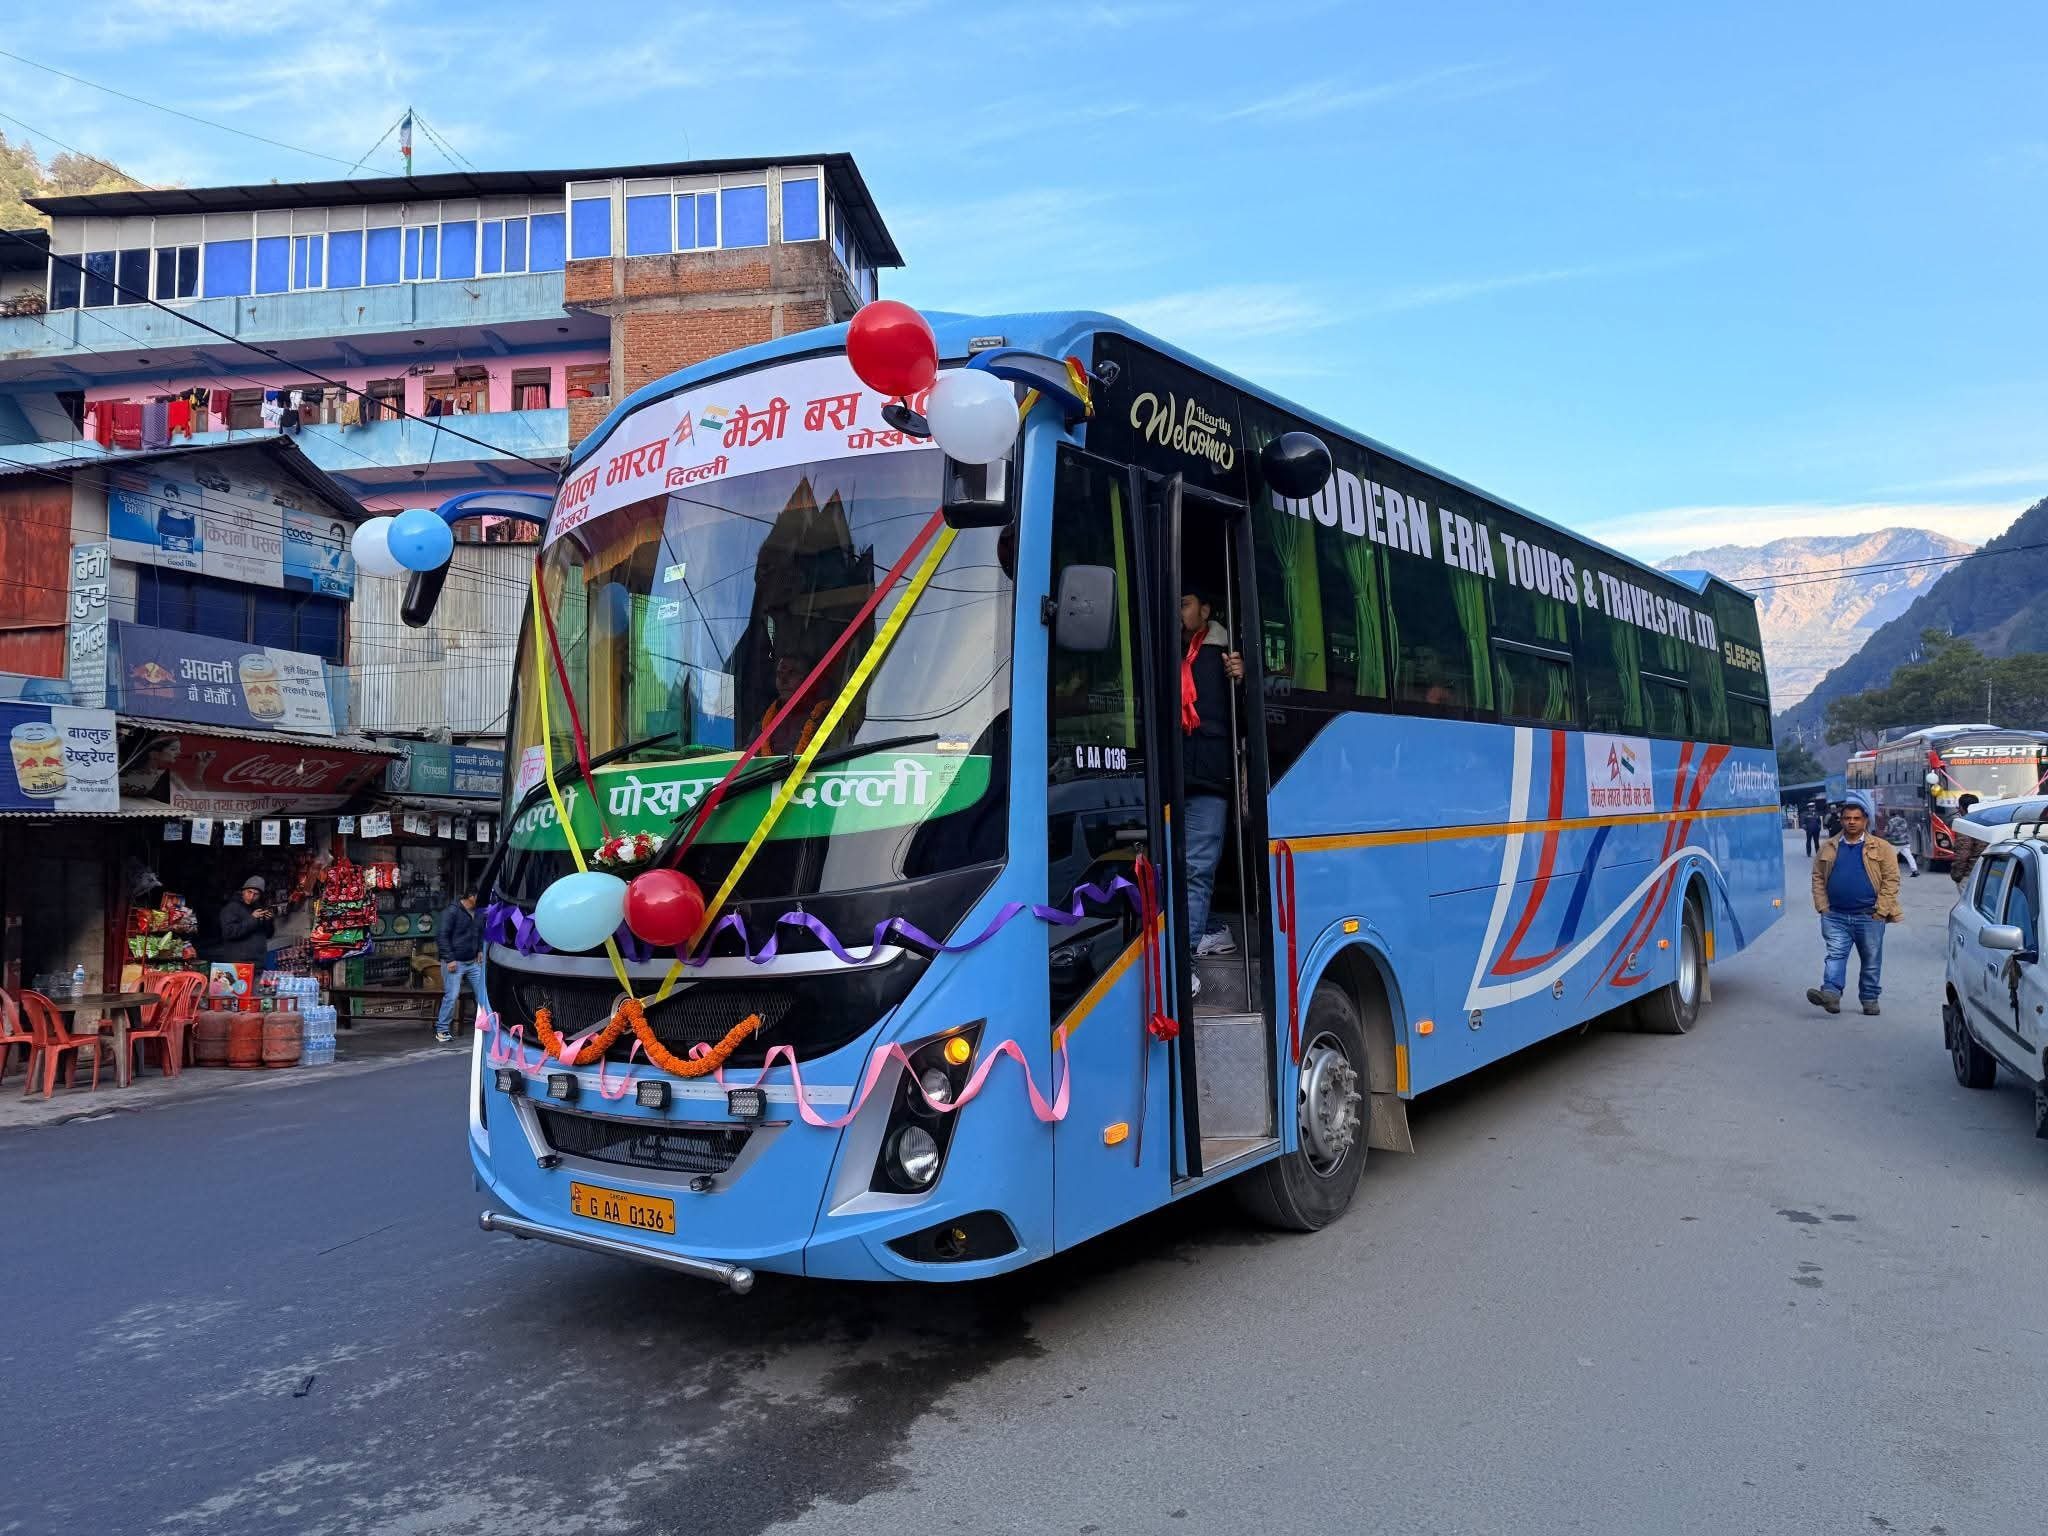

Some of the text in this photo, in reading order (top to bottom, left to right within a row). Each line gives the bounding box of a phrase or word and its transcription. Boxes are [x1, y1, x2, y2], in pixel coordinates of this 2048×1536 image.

[1130, 391, 1235, 470] Welcome
[556, 465, 601, 517] नेपाल
[606, 437, 670, 487] भारत
[723, 396, 790, 449] मैत्री
[804, 391, 863, 432] बस
[555, 504, 590, 536] पोखरा
[665, 455, 729, 489] दिल्ली
[1439, 507, 1496, 580] ERA
[1500, 532, 1578, 605] TOURS
[1582, 568, 1600, 609] &
[1598, 570, 1668, 635] TRAVELS
[1694, 610, 1720, 653] LTD.
[180, 658, 233, 684] असली
[1723, 640, 1763, 675] SLEEPER
[1076, 745, 1127, 770] G AA 0136
[1941, 745, 2048, 759] SRISHTI
[609, 776, 726, 816] पोखर
[590, 1197, 664, 1229] G AA 0136
